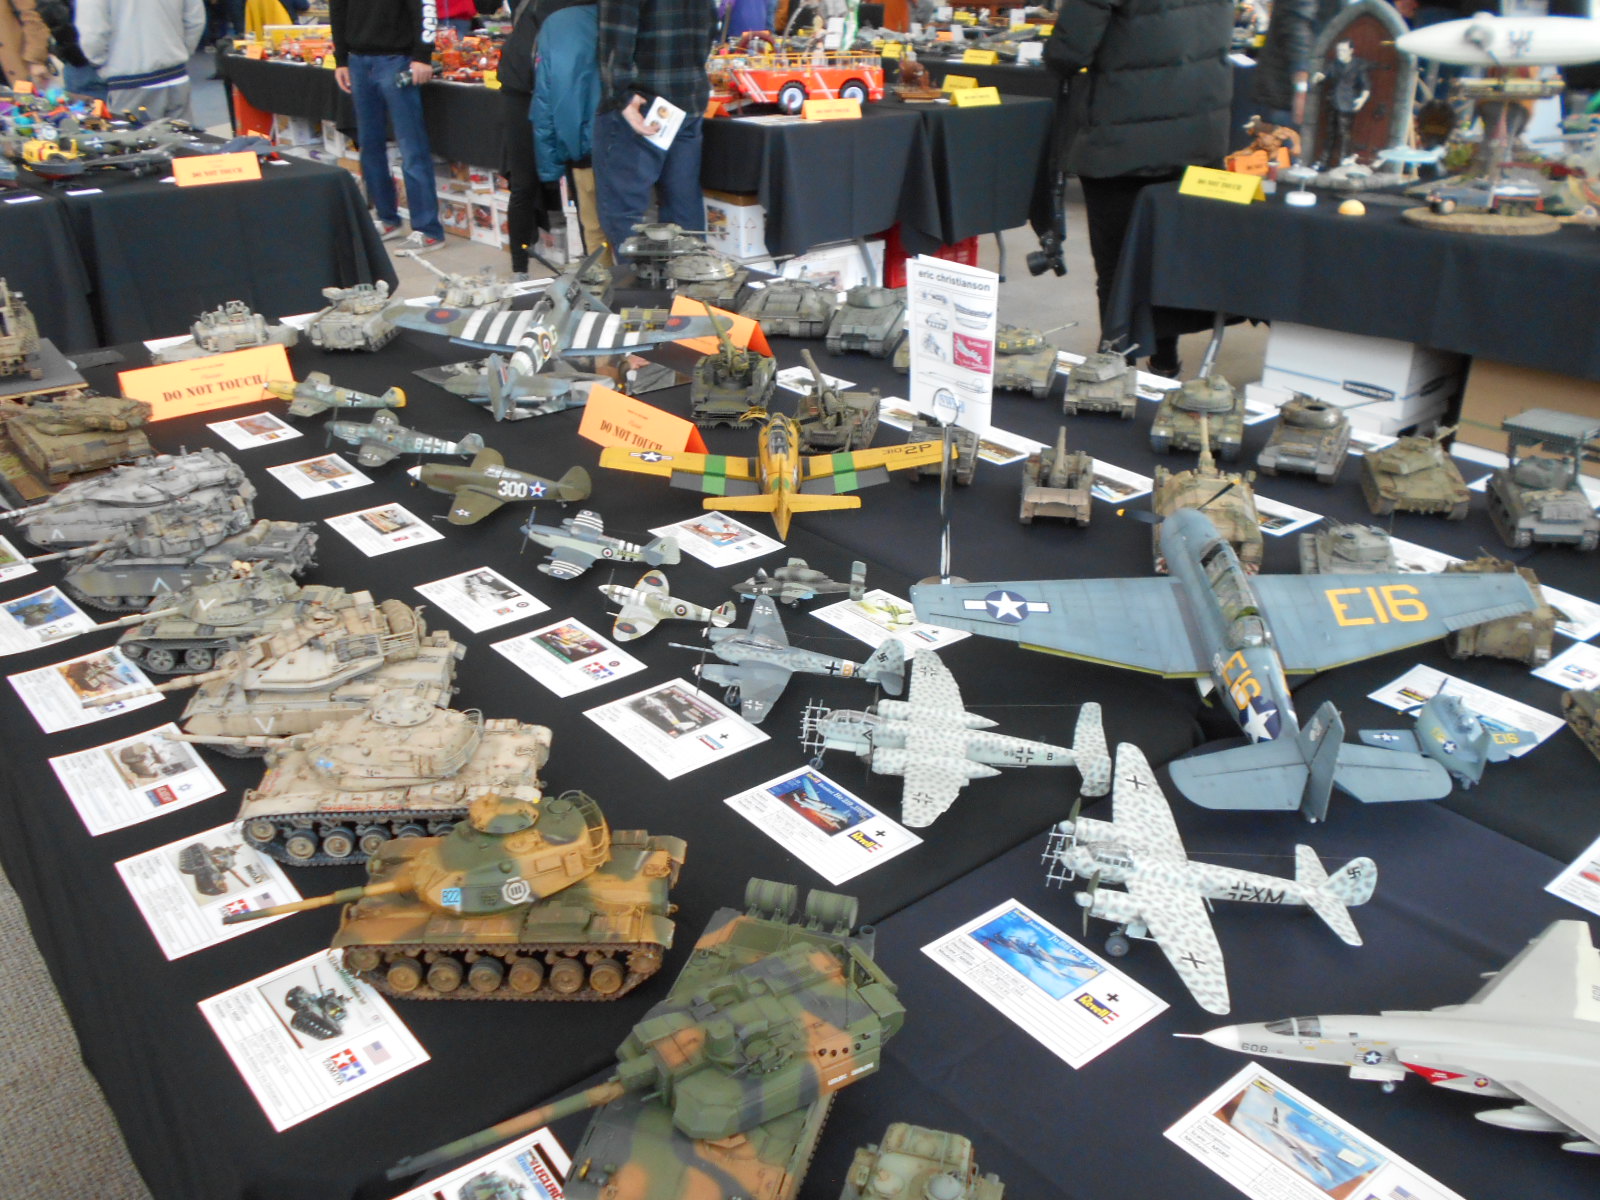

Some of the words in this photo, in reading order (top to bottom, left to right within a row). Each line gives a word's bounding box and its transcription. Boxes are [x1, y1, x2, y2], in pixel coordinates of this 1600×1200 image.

[918, 270, 934, 280] eric
[936, 273, 991, 291] christianson
[162, 389, 183, 402] DO
[185, 383, 214, 398] NOT
[218, 374, 264, 392] TOUCH
[600, 419, 613, 433] DO
[615, 425, 632, 442] NOT
[632, 433, 663, 451] TOUCH
[498, 480, 528, 498] 300
[1324, 583, 1429, 627] E16
[1222, 650, 1262, 710] E16
[1493, 733, 1520, 745] E16
[851, 831, 877, 849] Revell
[1248, 886, 1285, 904] XM
[1079, 995, 1112, 1018] Revell
[1241, 1043, 1269, 1054] 608
[322, 1058, 345, 1087] TAMIYA
[533, 1162, 564, 1200] LECLERC
